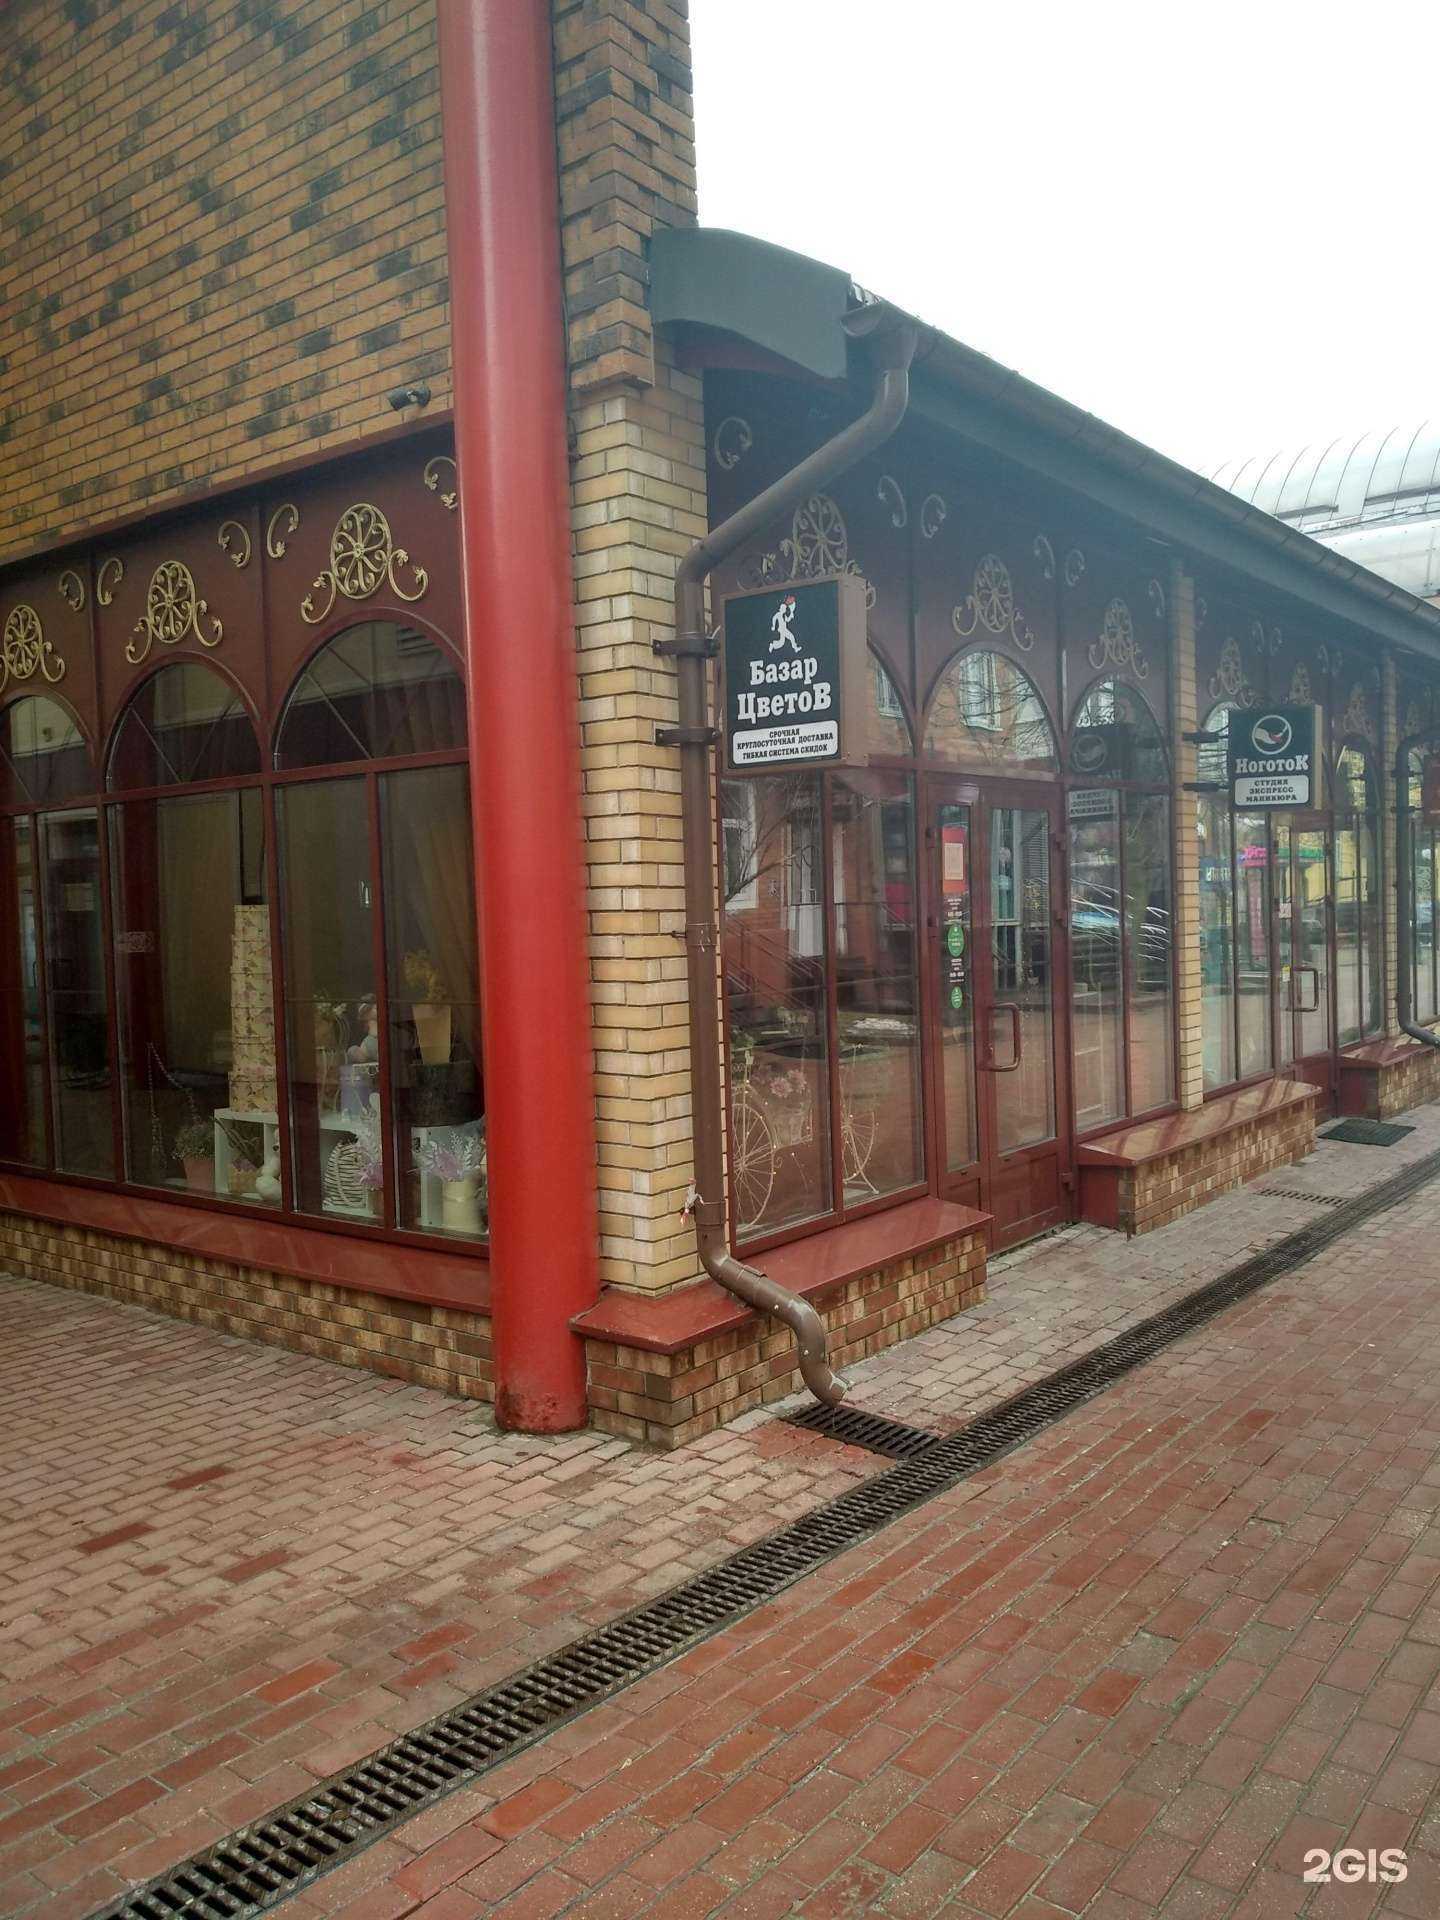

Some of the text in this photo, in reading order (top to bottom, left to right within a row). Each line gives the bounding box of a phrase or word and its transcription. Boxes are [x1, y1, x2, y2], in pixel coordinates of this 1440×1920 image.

[750, 657, 818, 685] Базар
[769, 728, 800, 738] СРОЧНАЯ
[737, 732, 833, 750] КРУГЛОСУТОЧНАЯ ДОСТАВКА
[743, 743, 828, 760] ГИБКАЯ СИСТЕМА СКИДОК
[1254, 779, 1289, 787] СТУДИЯ
[1249, 786, 1294, 795] ЭКСПРЕСС
[1246, 794, 1297, 803] МАНИКЮРА
